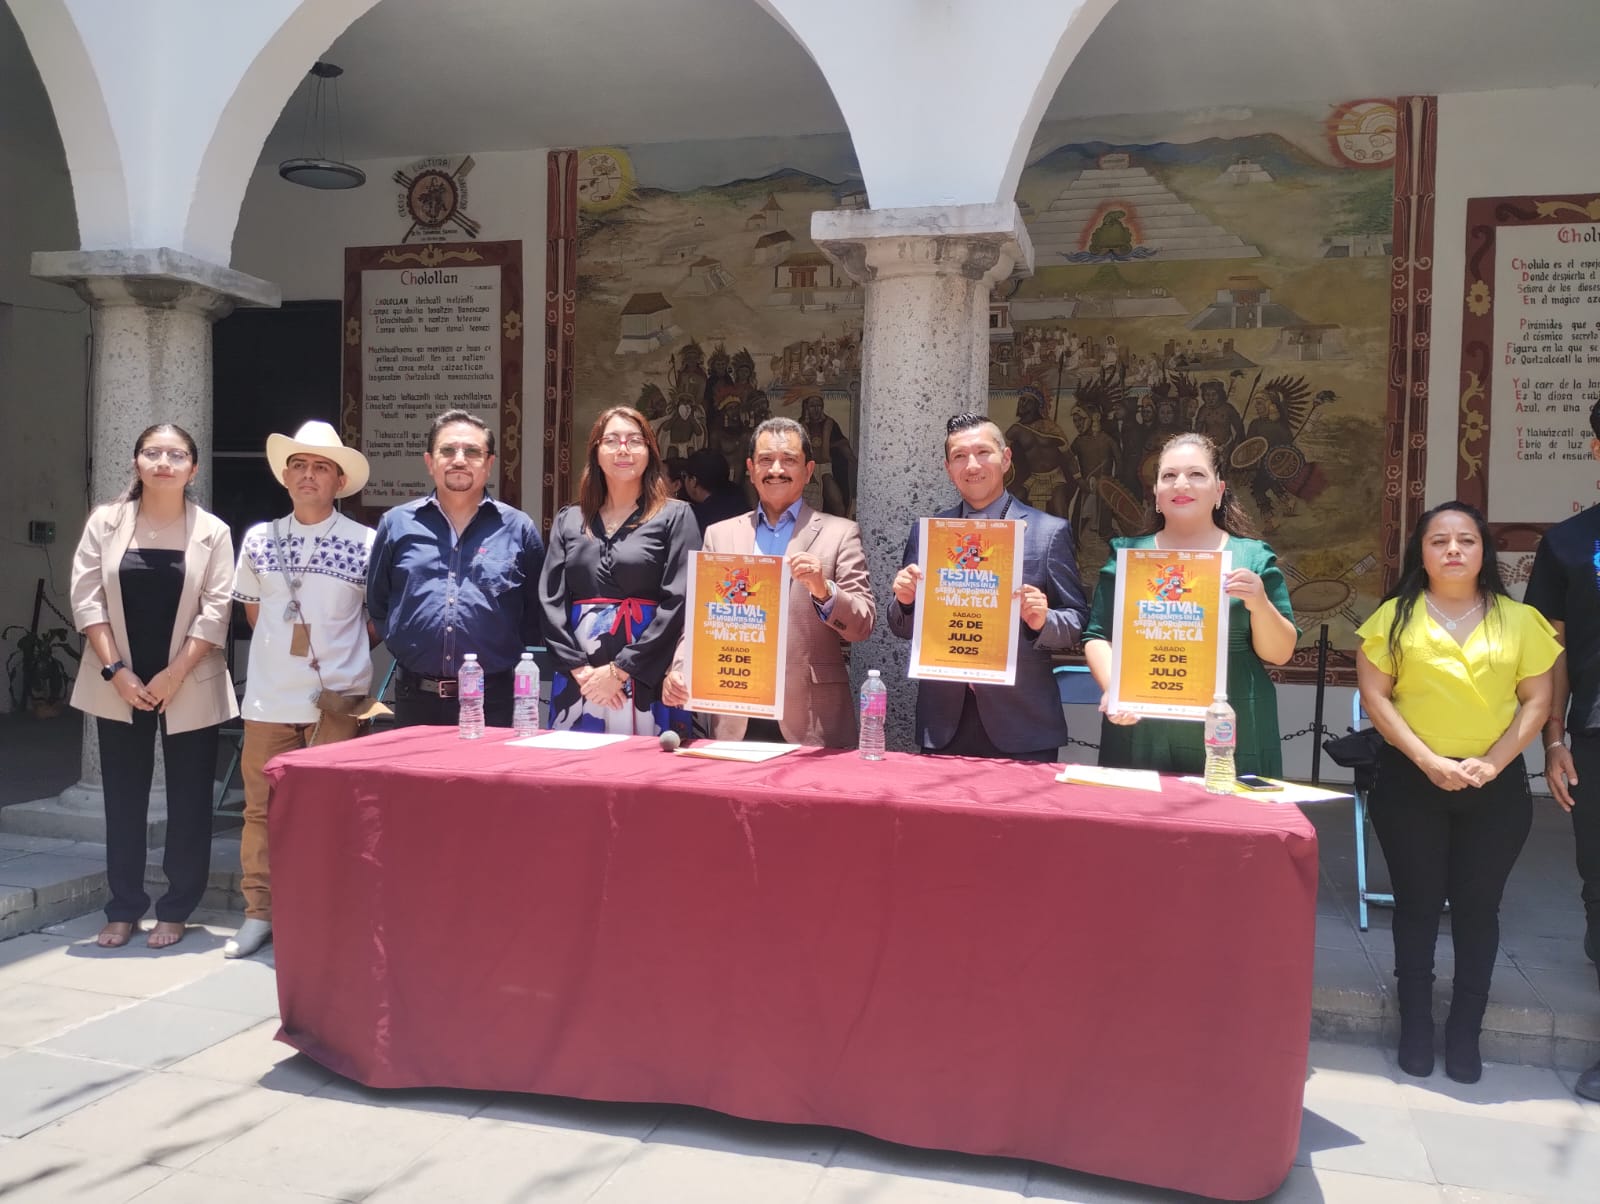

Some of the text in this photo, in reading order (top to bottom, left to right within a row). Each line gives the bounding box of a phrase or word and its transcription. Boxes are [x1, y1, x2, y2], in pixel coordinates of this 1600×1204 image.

[1558, 226, 1600, 243] Chol
[1512, 258, 1550, 270] Cholula
[1554, 261, 1562, 269] es
[1568, 259, 1574, 268] el
[400, 270, 458, 285] Cholollan
[1522, 271, 1596, 282] Donde despierta el
[1517, 284, 1543, 294] Señora
[1548, 284, 1556, 293] de
[1560, 284, 1571, 292] los
[1523, 295, 1536, 305] En
[1542, 295, 1548, 304] el
[1520, 318, 1562, 330] Pirámides
[1572, 321, 1586, 330] que
[1523, 332, 1530, 340] el
[1507, 342, 1537, 355] Figura
[1556, 343, 1563, 352] la
[1568, 345, 1582, 354] que
[1505, 355, 1516, 365] De
[1575, 355, 1582, 363] la
[1560, 378, 1569, 388] de
[1574, 378, 1582, 389] la
[1534, 391, 1541, 400] la
[1548, 391, 1572, 400] diosa
[1518, 439, 1582, 448] Ebrio de luz
[1517, 451, 1542, 460] Canta
[940, 568, 994, 583] FESTIVAL
[946, 594, 998, 608] MIXTECA
[708, 602, 764, 618] FESTIVAL
[1139, 600, 1201, 614] FESTIVAL
[949, 620, 983, 629] 26 DE
[714, 629, 766, 643] MIXTECA
[948, 633, 982, 642] JULIO
[1145, 627, 1203, 641] MIXTECA
[949, 646, 979, 656] 2025
[718, 654, 751, 664] 26 DE
[1150, 654, 1187, 664] 26 DE
[717, 667, 751, 677] JULIO
[1149, 668, 1186, 677] JULIO
[720, 680, 748, 689] 2025
[1152, 681, 1184, 690] 2025
